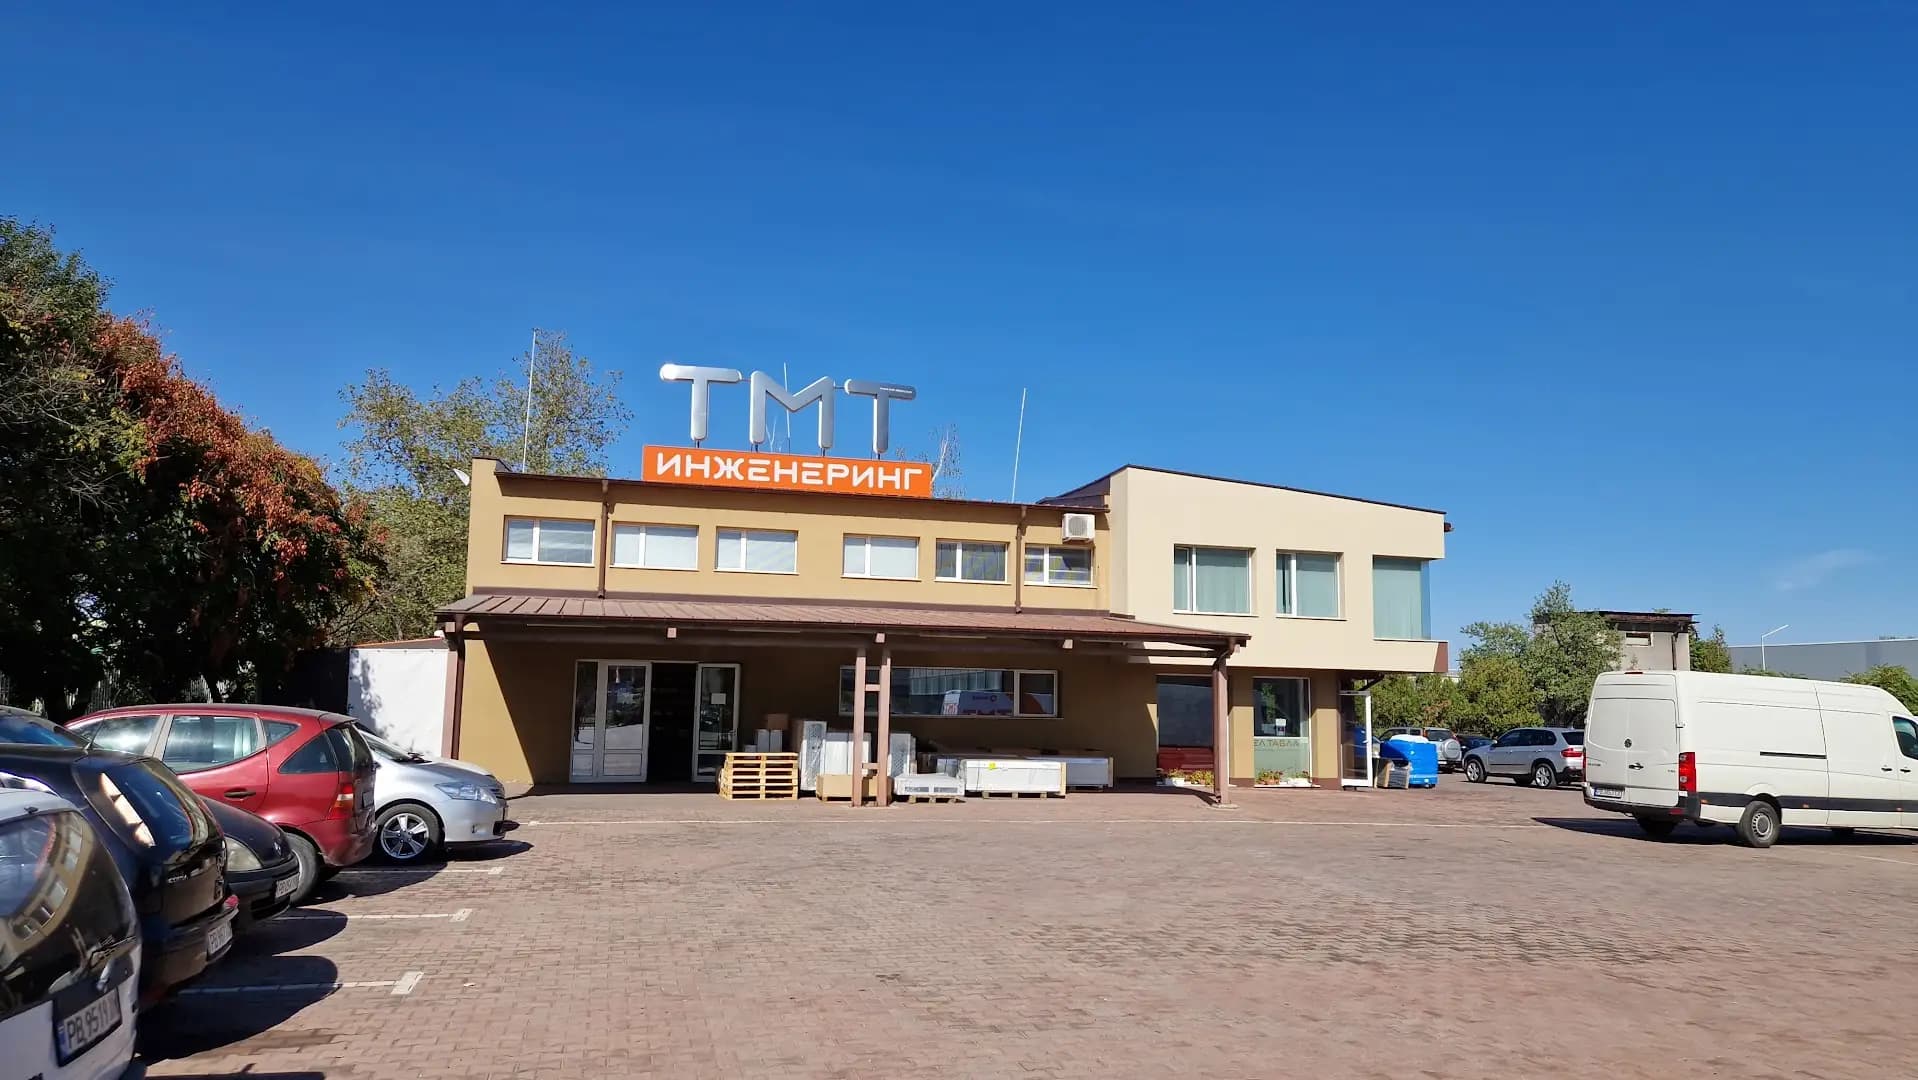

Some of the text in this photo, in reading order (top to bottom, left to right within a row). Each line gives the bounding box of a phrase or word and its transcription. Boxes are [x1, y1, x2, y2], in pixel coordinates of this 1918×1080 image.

[660, 363, 917, 454] ТМТ
[656, 452, 922, 490] ИНЖЕНЕРИНГ
[67, 1016, 86, 1049] PB
